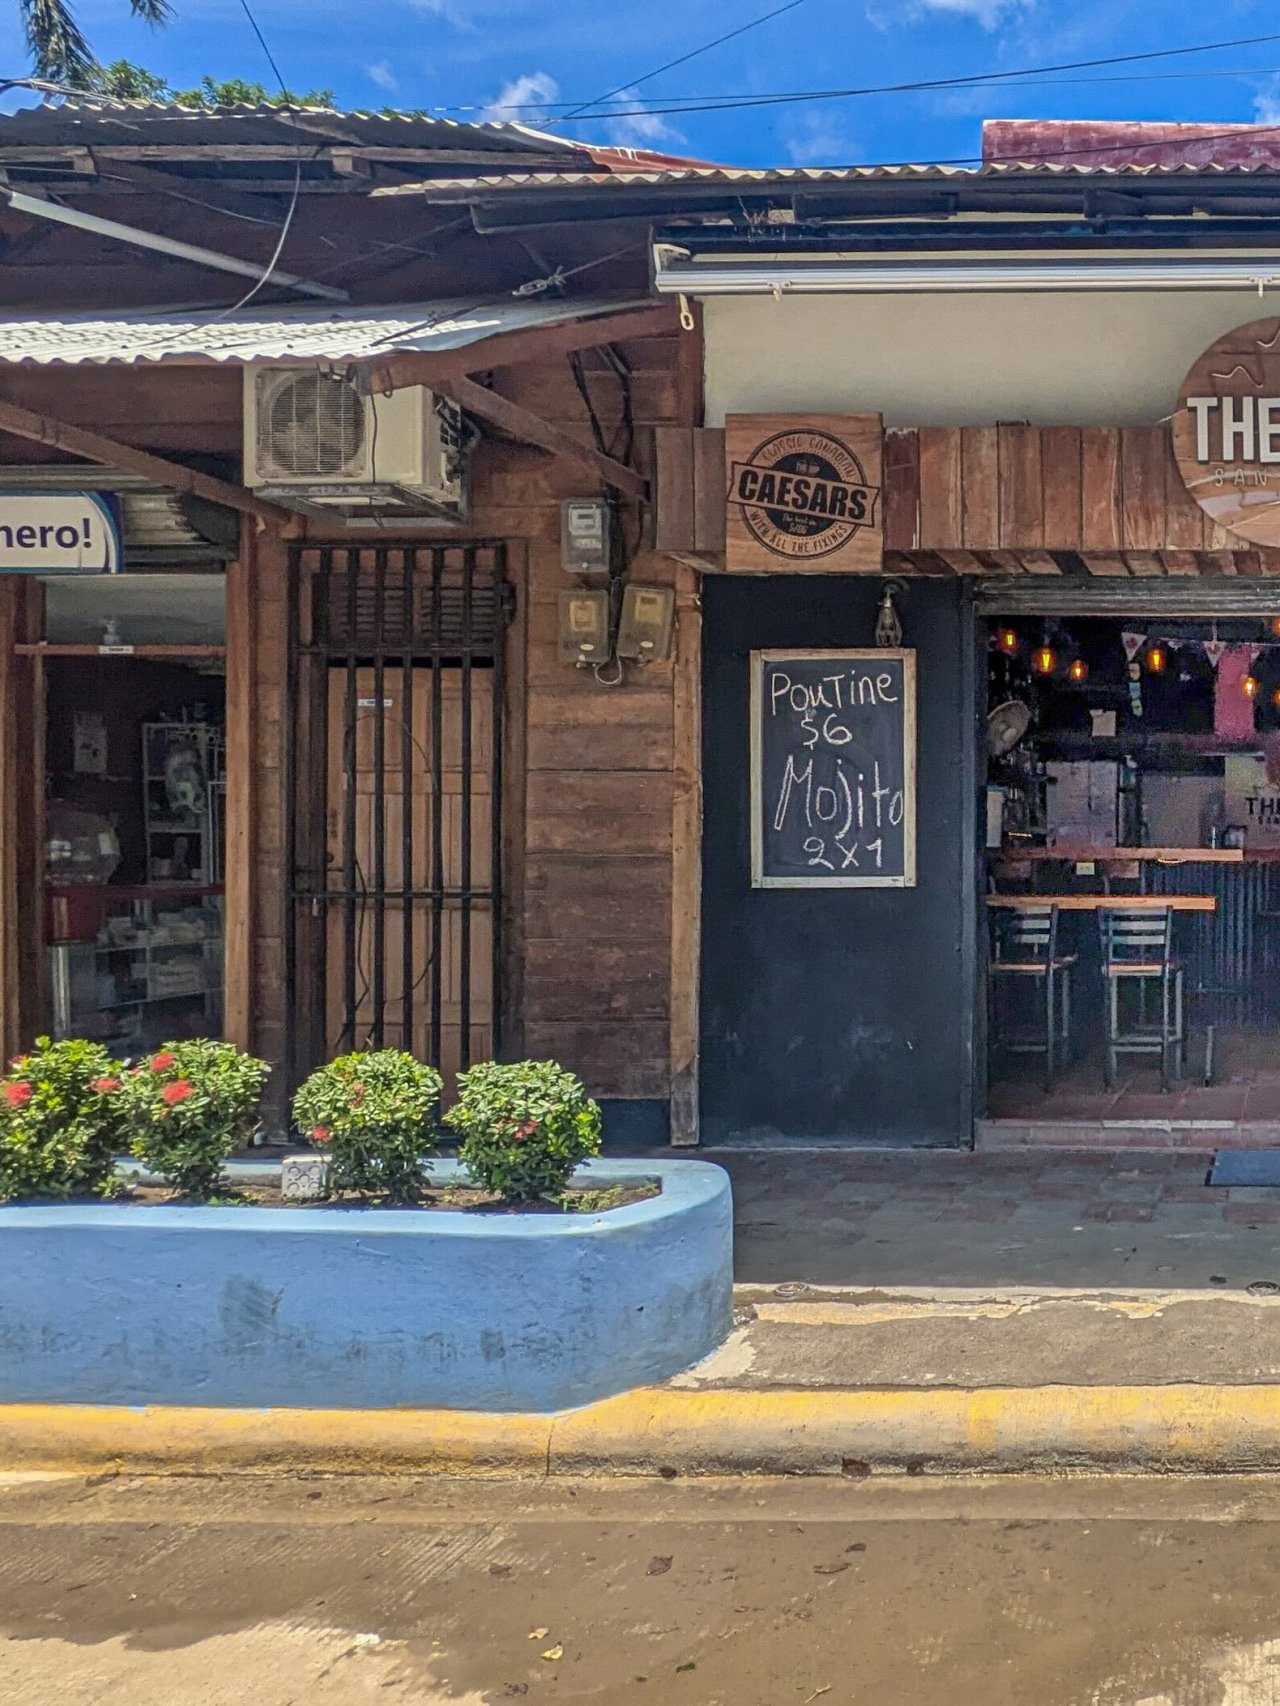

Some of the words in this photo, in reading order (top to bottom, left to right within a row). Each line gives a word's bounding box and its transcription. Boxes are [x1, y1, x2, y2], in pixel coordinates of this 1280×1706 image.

[762, 436, 802, 462] CLASSIC
[809, 437, 858, 478] CANADIAN
[1215, 467, 1268, 487] SAN
[738, 469, 868, 520] CAESARS
[750, 511, 768, 539] WITH
[769, 533, 786, 549] ALL
[792, 541, 809, 553] THE
[813, 525, 848, 551] FIXINGS
[801, 711, 852, 750] $6
